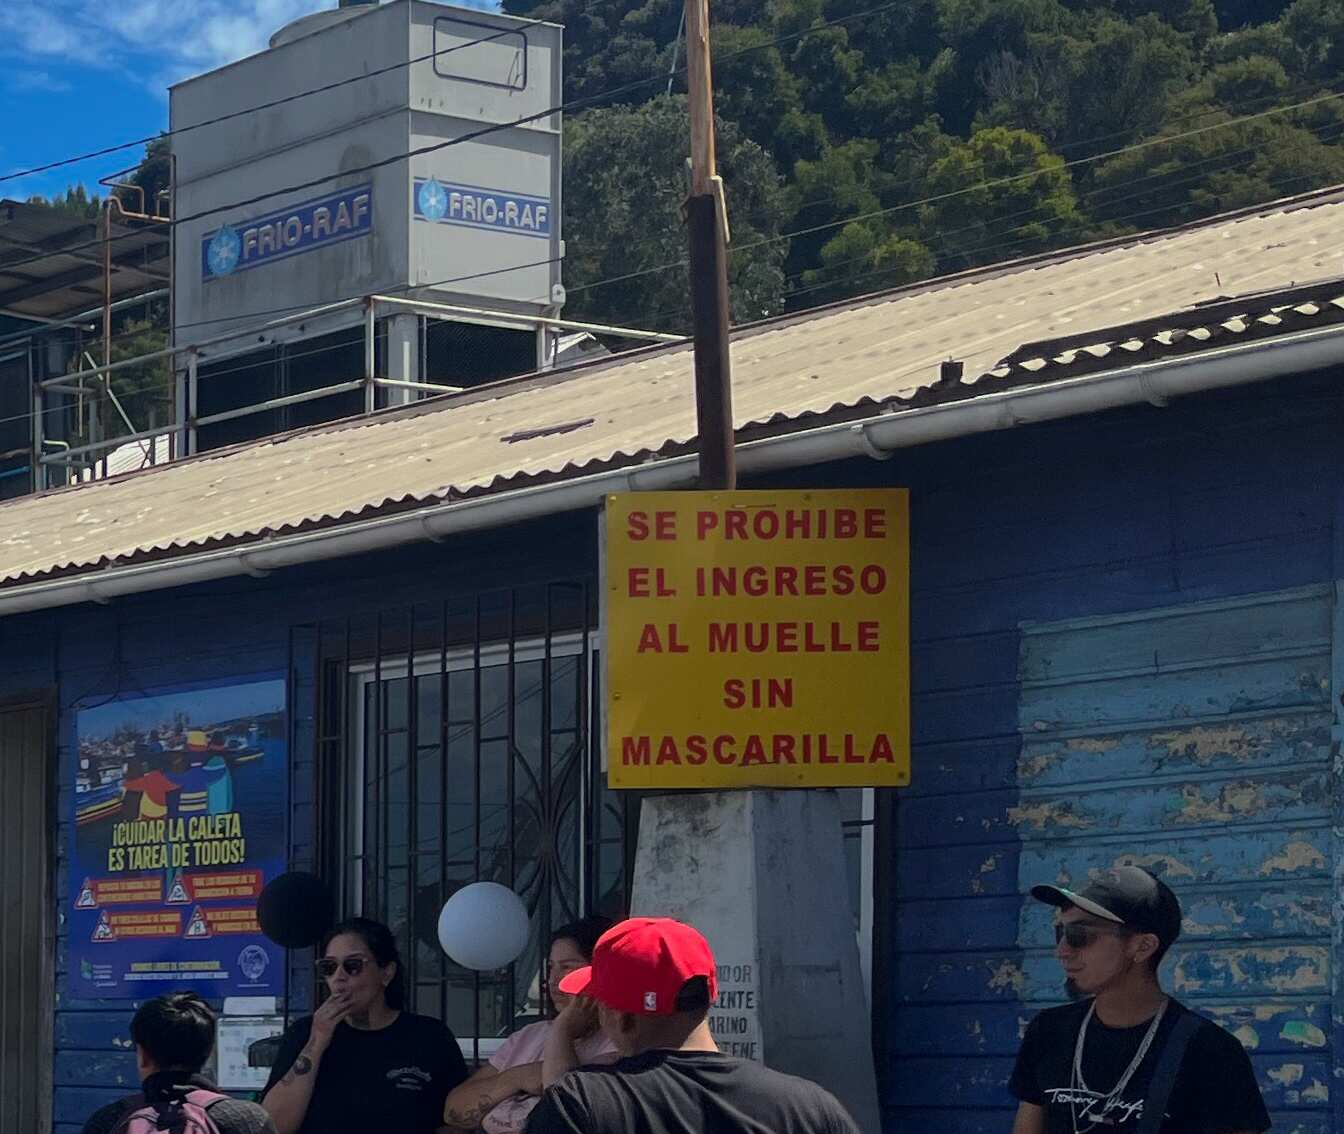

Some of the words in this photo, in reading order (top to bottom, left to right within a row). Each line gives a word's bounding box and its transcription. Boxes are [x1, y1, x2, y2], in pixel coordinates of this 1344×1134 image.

[242, 194, 370, 261] FRIO-RAF
[448, 191, 548, 231] FRIO-RAF
[626, 511, 677, 541] SE
[696, 508, 888, 541] PROHIBE
[627, 567, 676, 598] EL
[696, 564, 888, 597] INGRESO
[637, 623, 689, 654] AL
[708, 621, 881, 653] MUELLE
[722, 678, 794, 710] SIN
[621, 733, 895, 767] MASCARILLA
[112, 818, 166, 848] ¡CUIDAR
[168, 816, 186, 843] LA
[188, 812, 242, 841] CALETA
[107, 846, 125, 872] ES
[127, 843, 169, 871] TAREA
[171, 841, 191, 868] DE
[193, 838, 246, 866] TODOS!
